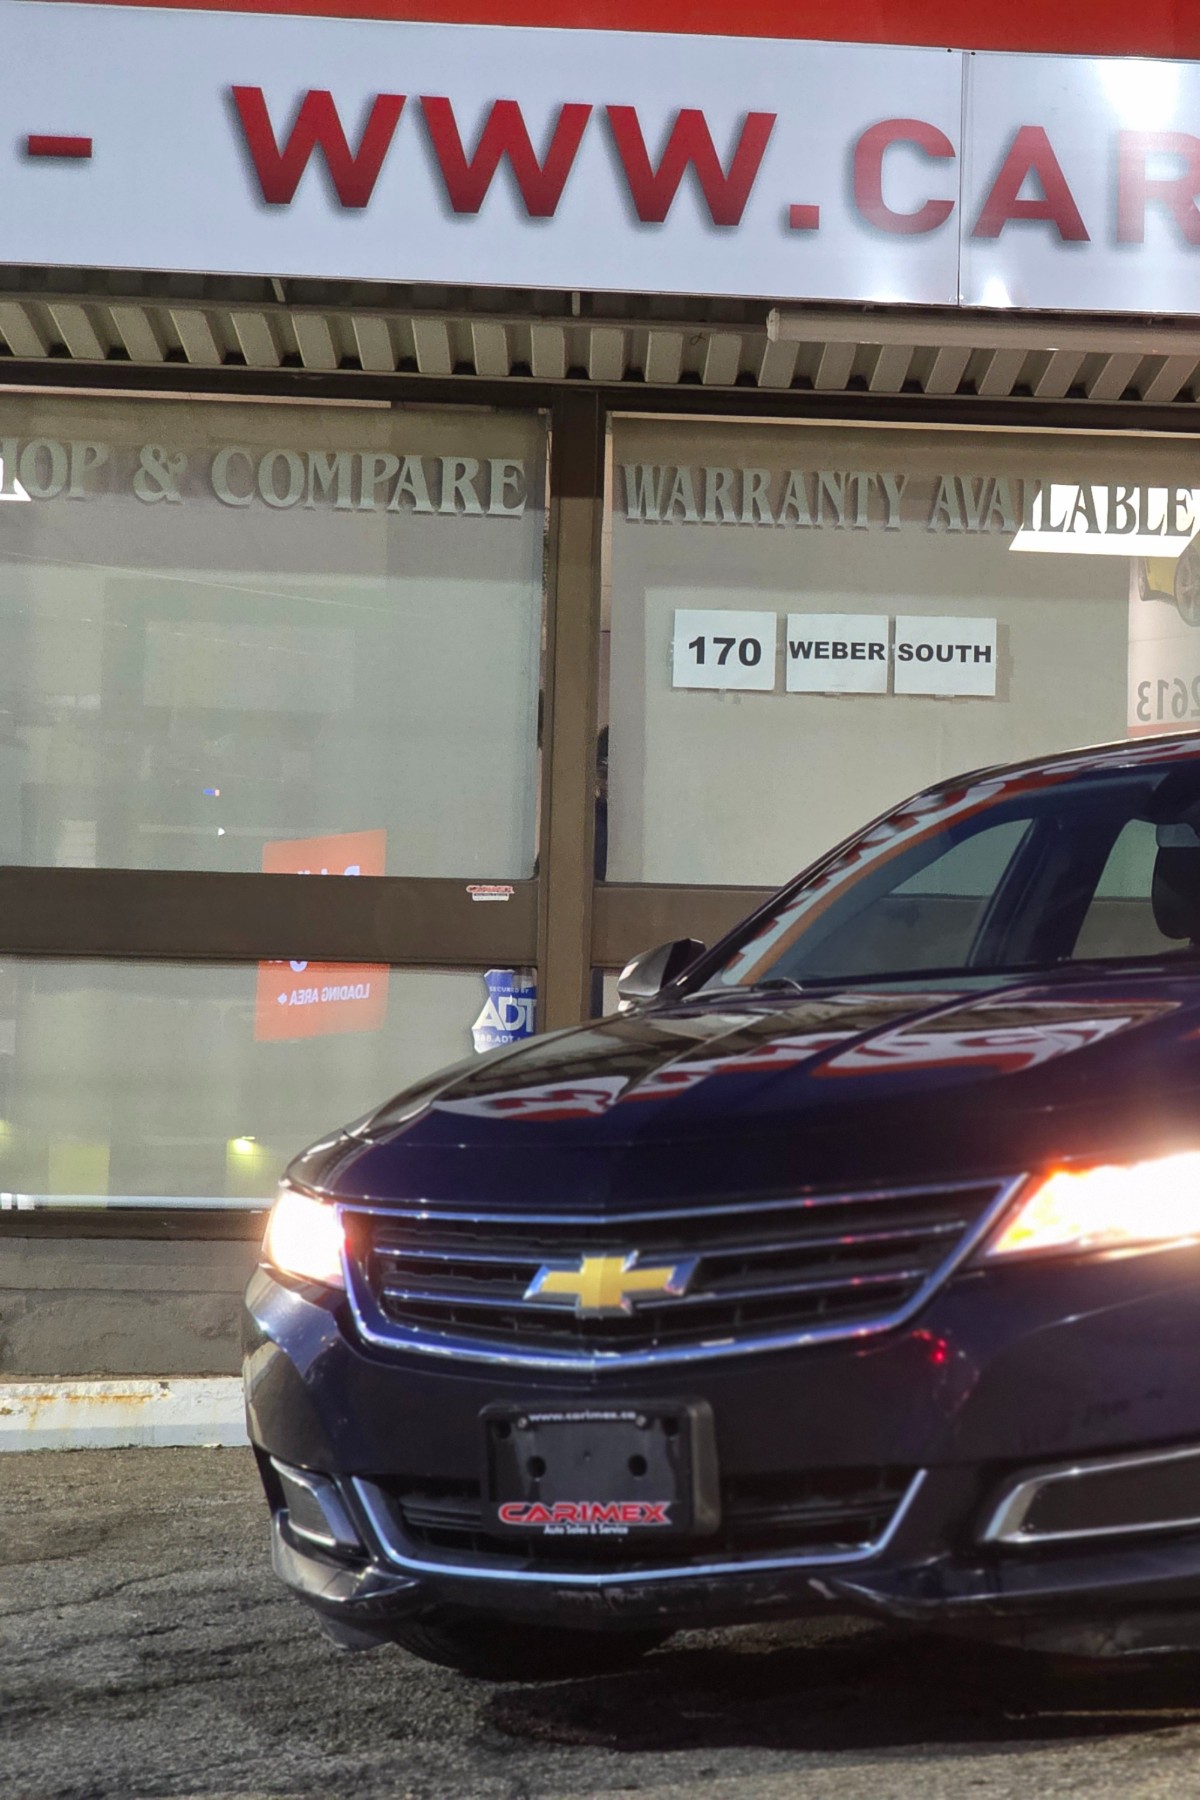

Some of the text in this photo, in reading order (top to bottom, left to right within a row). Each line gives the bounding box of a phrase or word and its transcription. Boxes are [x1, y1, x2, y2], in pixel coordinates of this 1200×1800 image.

[133, 443, 188, 504] &
[211, 446, 528, 516] COMPARE
[621, 464, 1196, 537] WARRANTY AVAILABLE
[688, 636, 992, 666] 170 WEBER SOUTH
[489, 986, 519, 994] SECURED
[472, 995, 537, 1033] ADT
[528, 1411, 637, 1422] www.carimex.ca
[498, 1502, 672, 1525] CARIMEX
[544, 1524, 629, 1534] Auto Sales & Service
